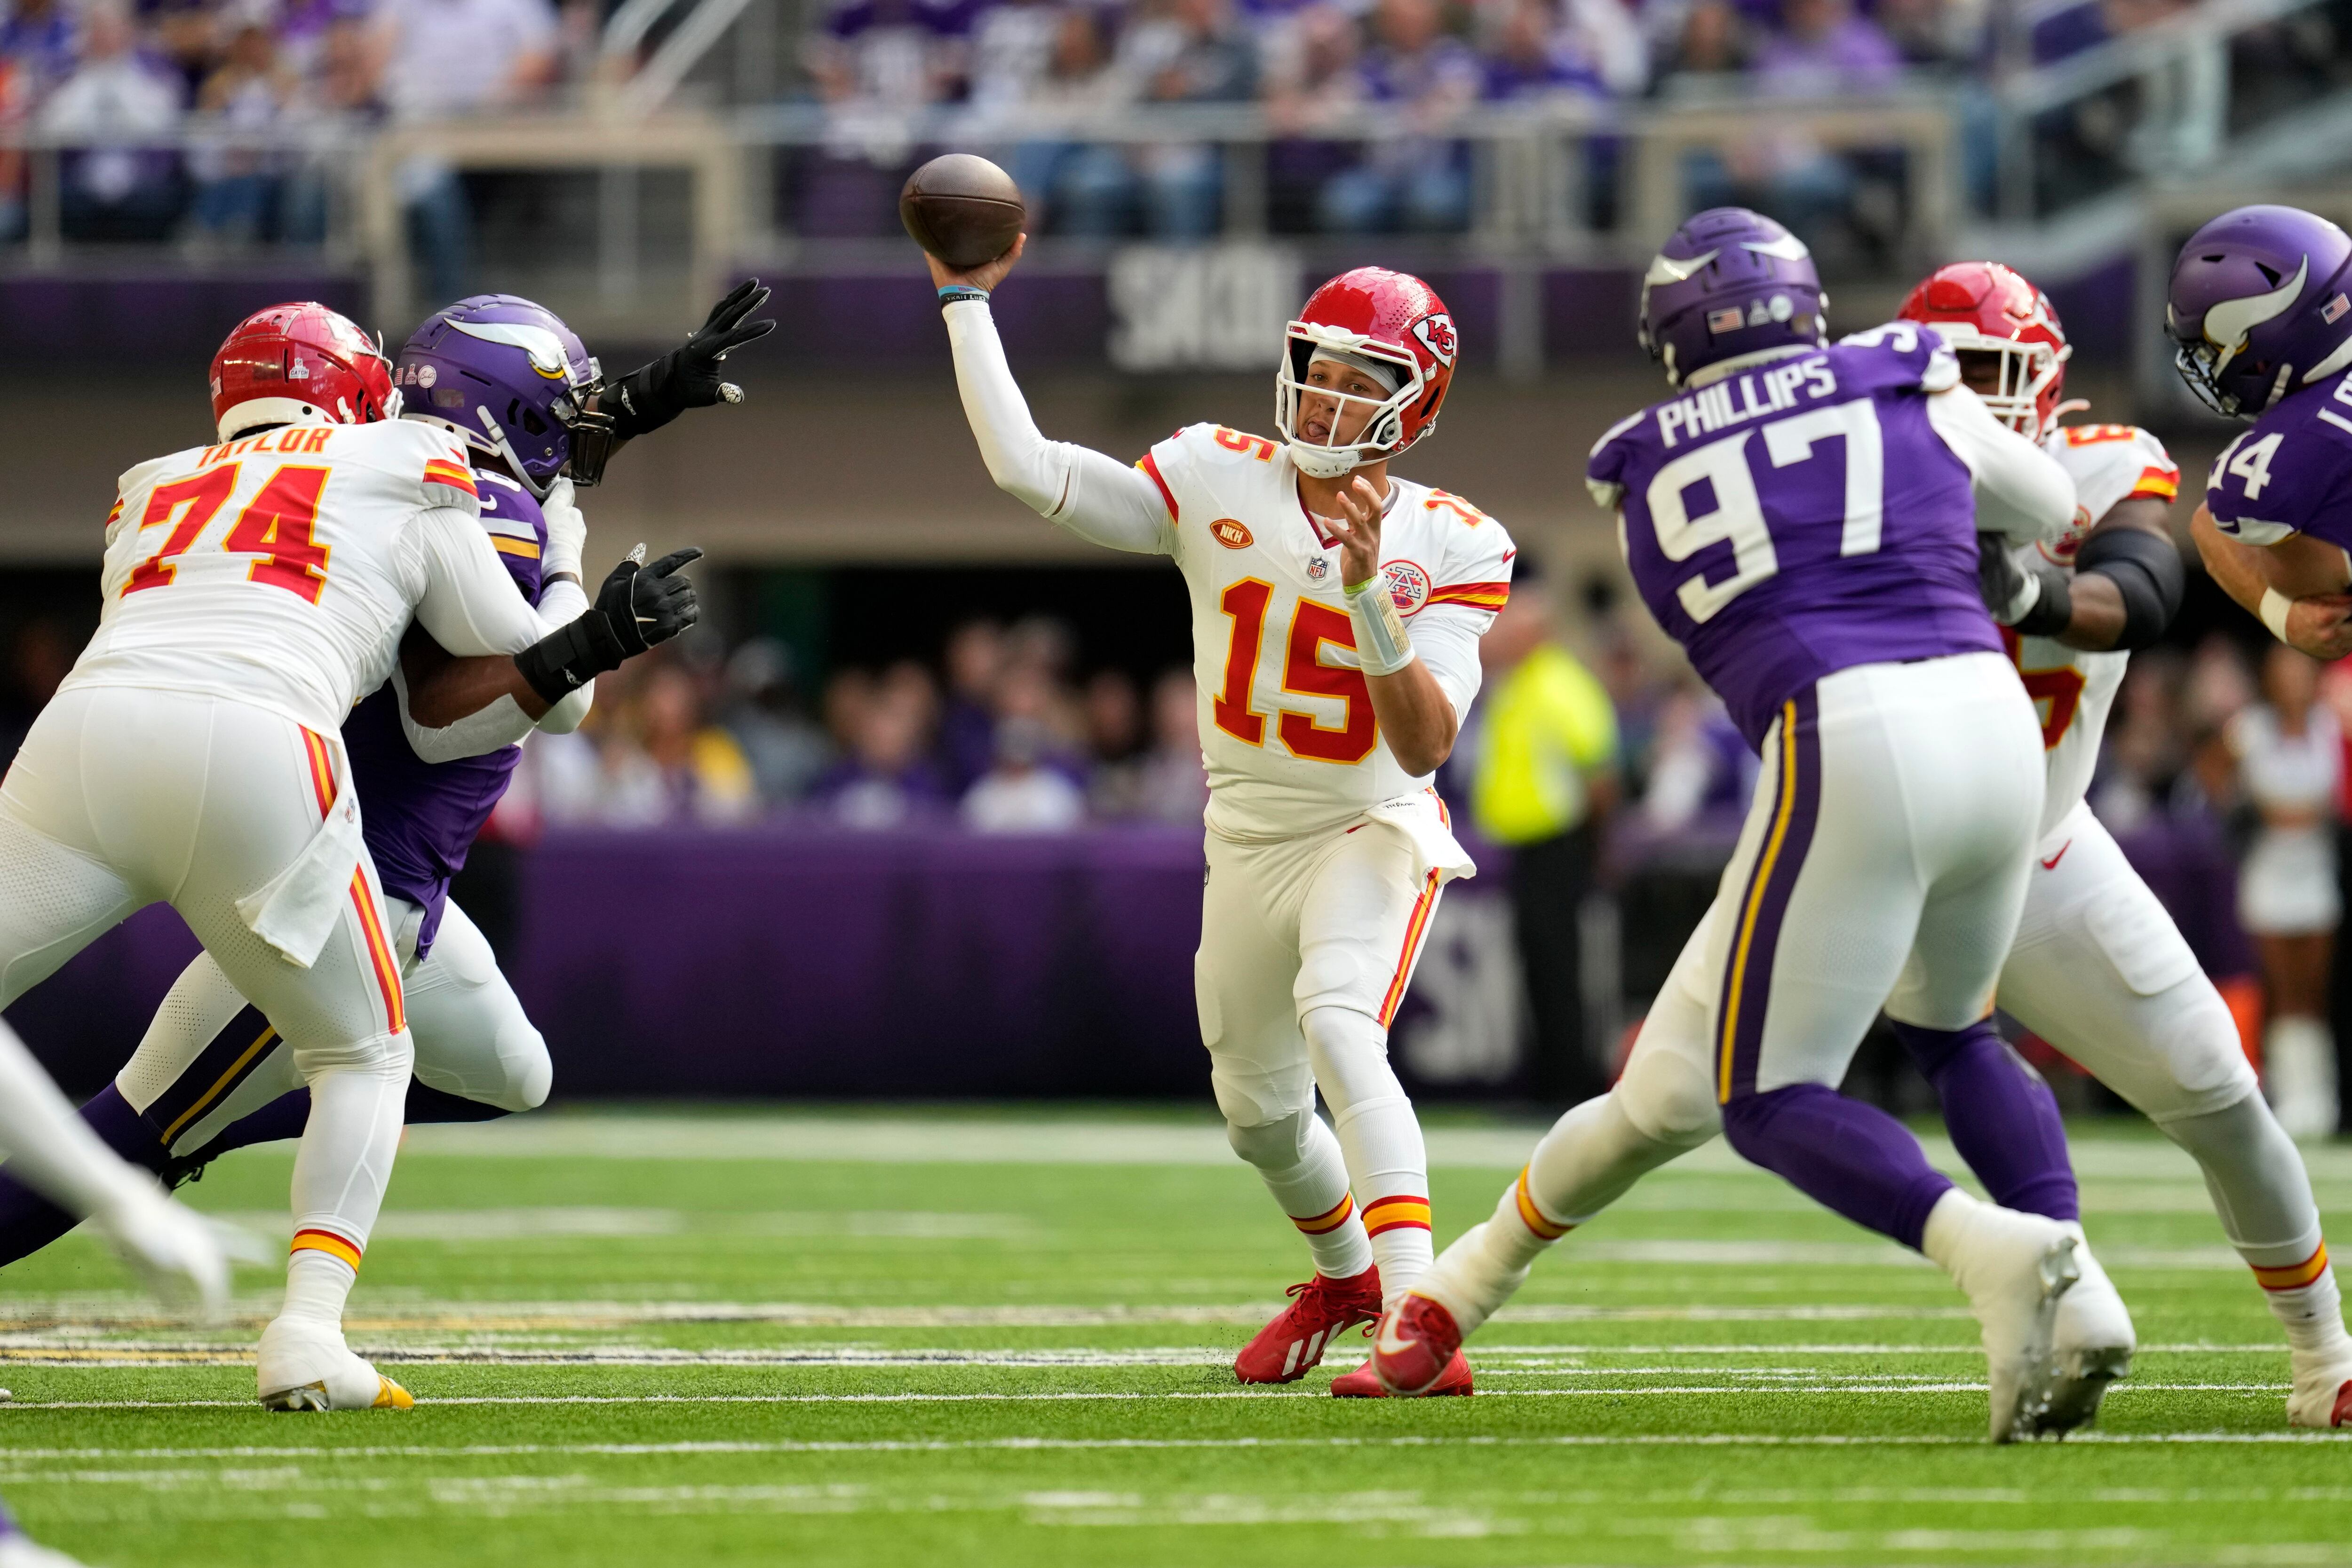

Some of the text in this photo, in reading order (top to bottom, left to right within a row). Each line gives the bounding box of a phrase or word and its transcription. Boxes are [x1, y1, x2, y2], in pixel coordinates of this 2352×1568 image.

[1426, 319, 1454, 356] KC
[1657, 356, 1837, 448] PHILLIPS
[1214, 424, 1278, 463] 5
[1423, 488, 1489, 530] 1
[1646, 397, 1883, 624] 97
[120, 461, 332, 606] 74
[1219, 524, 1244, 544] NKH
[1309, 565, 1323, 577] NFL
[1214, 576, 1379, 765] 15
